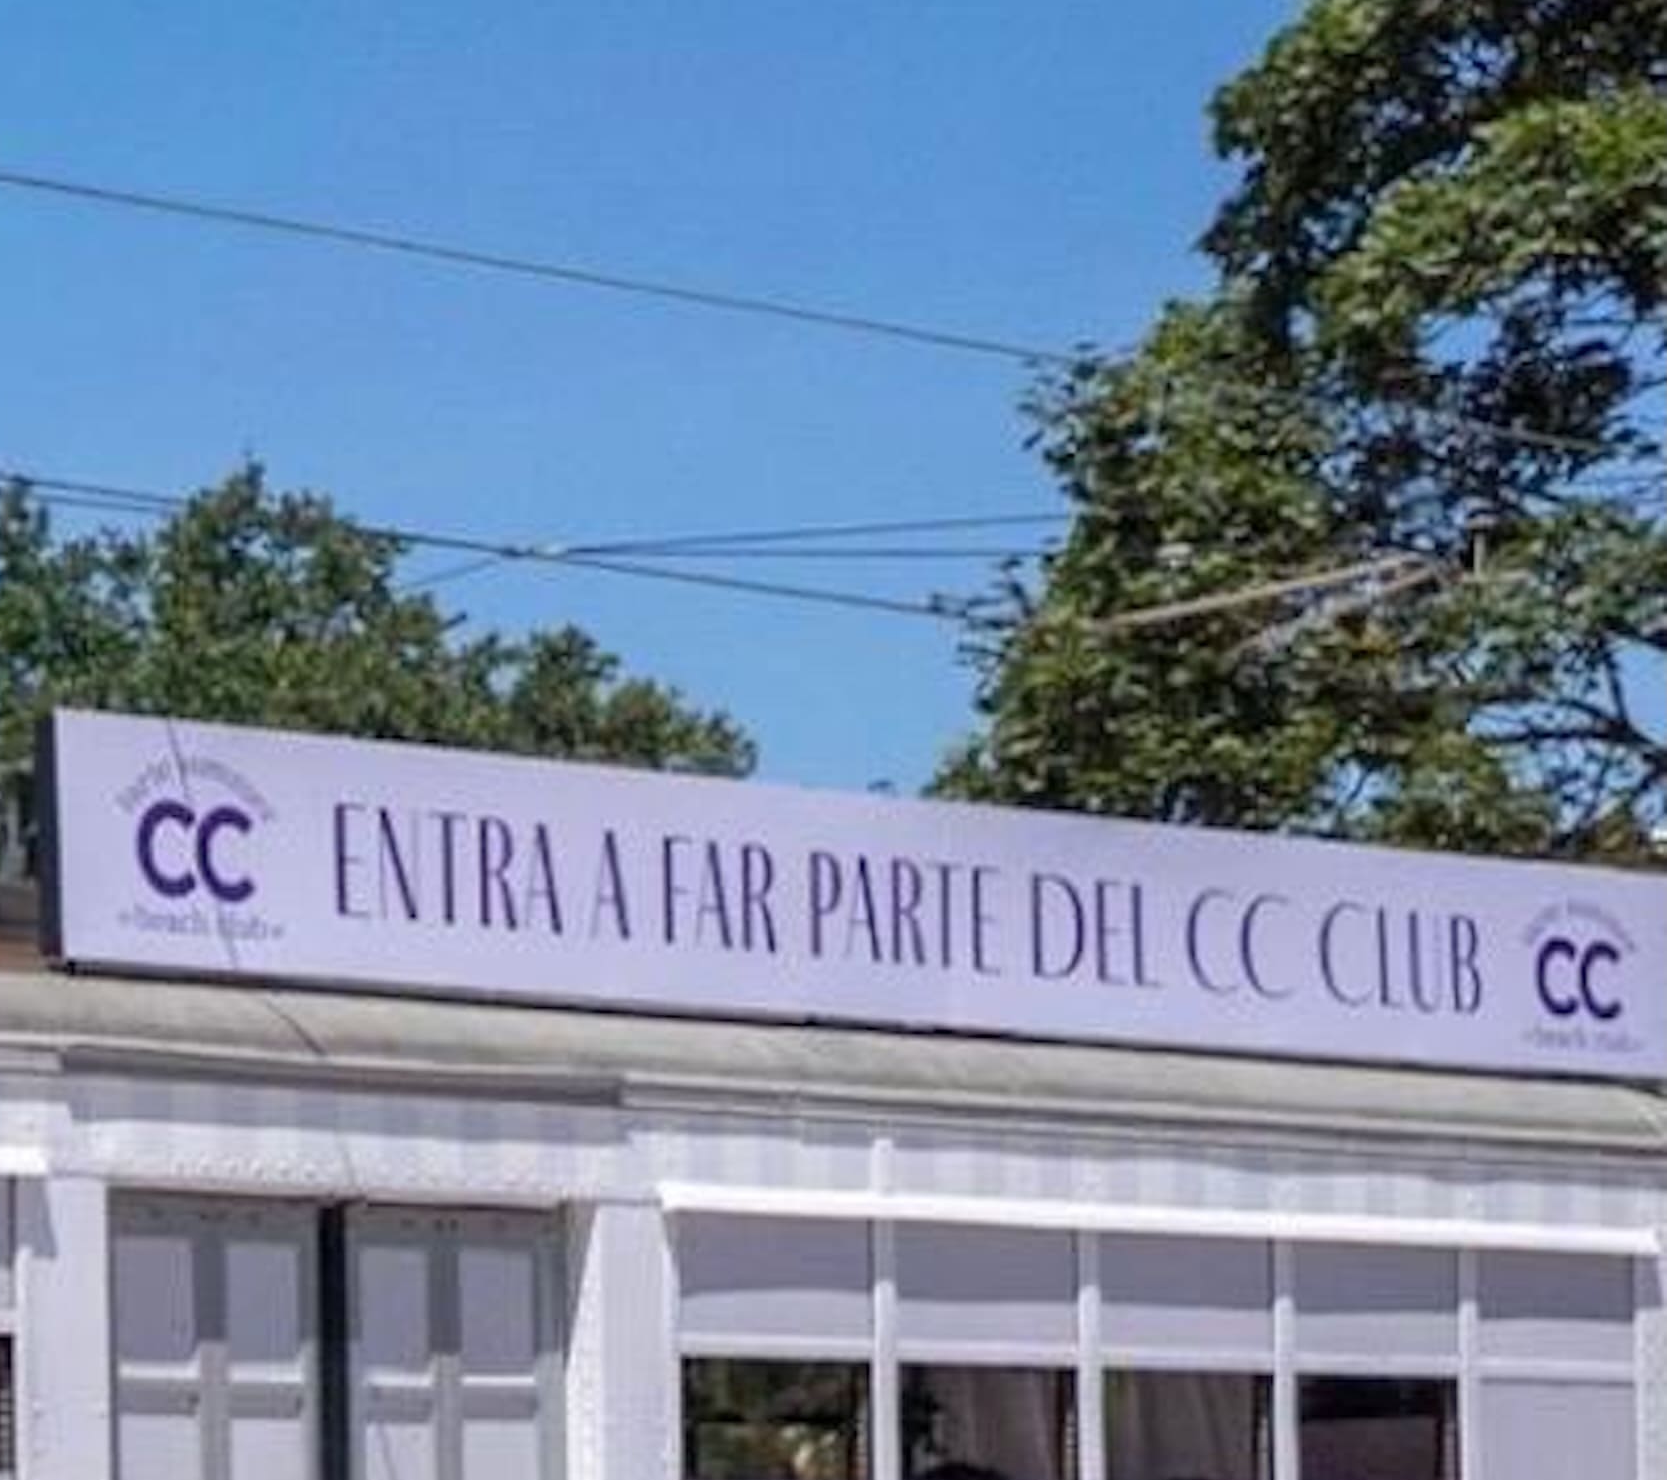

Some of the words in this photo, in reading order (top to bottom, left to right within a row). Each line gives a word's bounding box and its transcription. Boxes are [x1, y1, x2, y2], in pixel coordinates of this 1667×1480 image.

[136, 798, 254, 903] CC
[333, 801, 563, 936] ENTRA
[590, 829, 631, 941] A
[662, 835, 777, 954] FAR
[807, 850, 1001, 975] PARTE
[1030, 872, 1160, 989] DEL
[1187, 887, 1291, 999] CC
[1319, 901, 1483, 1016] CLUB
[1537, 937, 1622, 1022] CC
